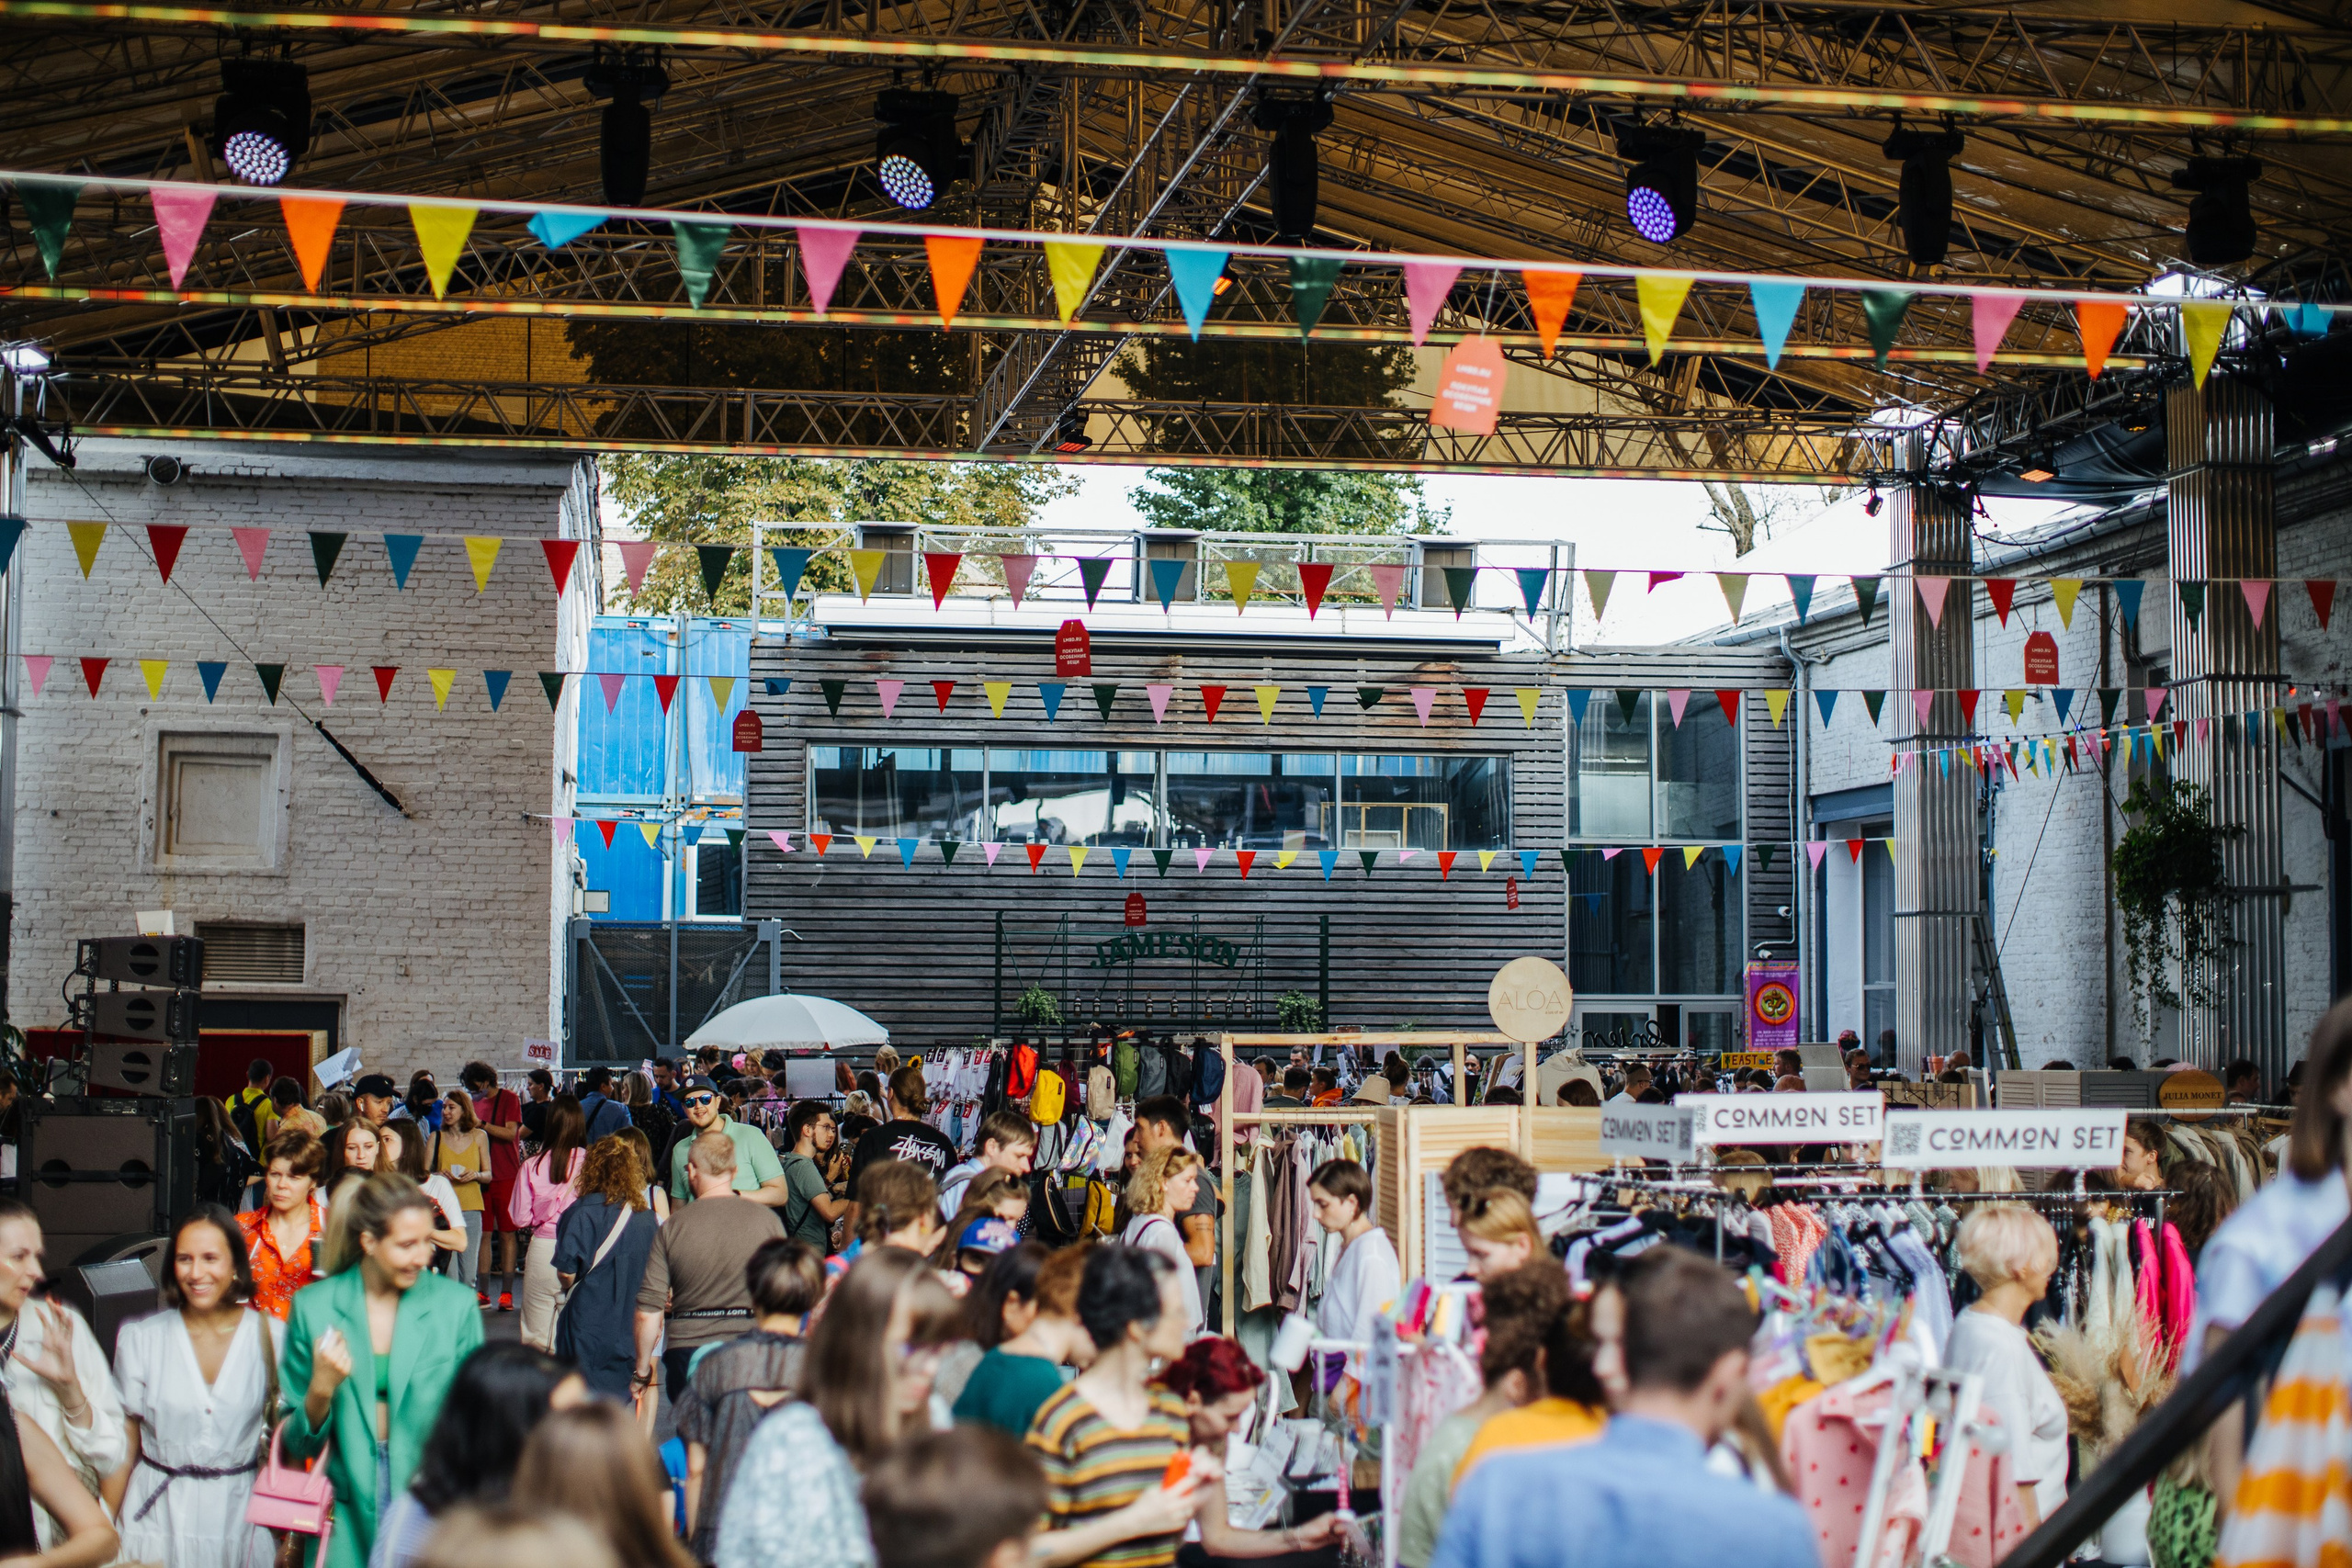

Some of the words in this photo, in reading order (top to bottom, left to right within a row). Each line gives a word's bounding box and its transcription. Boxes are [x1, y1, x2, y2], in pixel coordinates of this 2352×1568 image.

[1091, 931, 1242, 970] JAMESON
[528, 1047, 551, 1059] SALE
[1732, 1055, 1758, 1066] EAST
[2163, 1092, 2189, 1100] JULIA
[2190, 1091, 2222, 1100] MONET
[1838, 1105, 1878, 1127] SET
[1657, 1120, 1677, 1145] SET
[2073, 1125, 2120, 1150] SET
